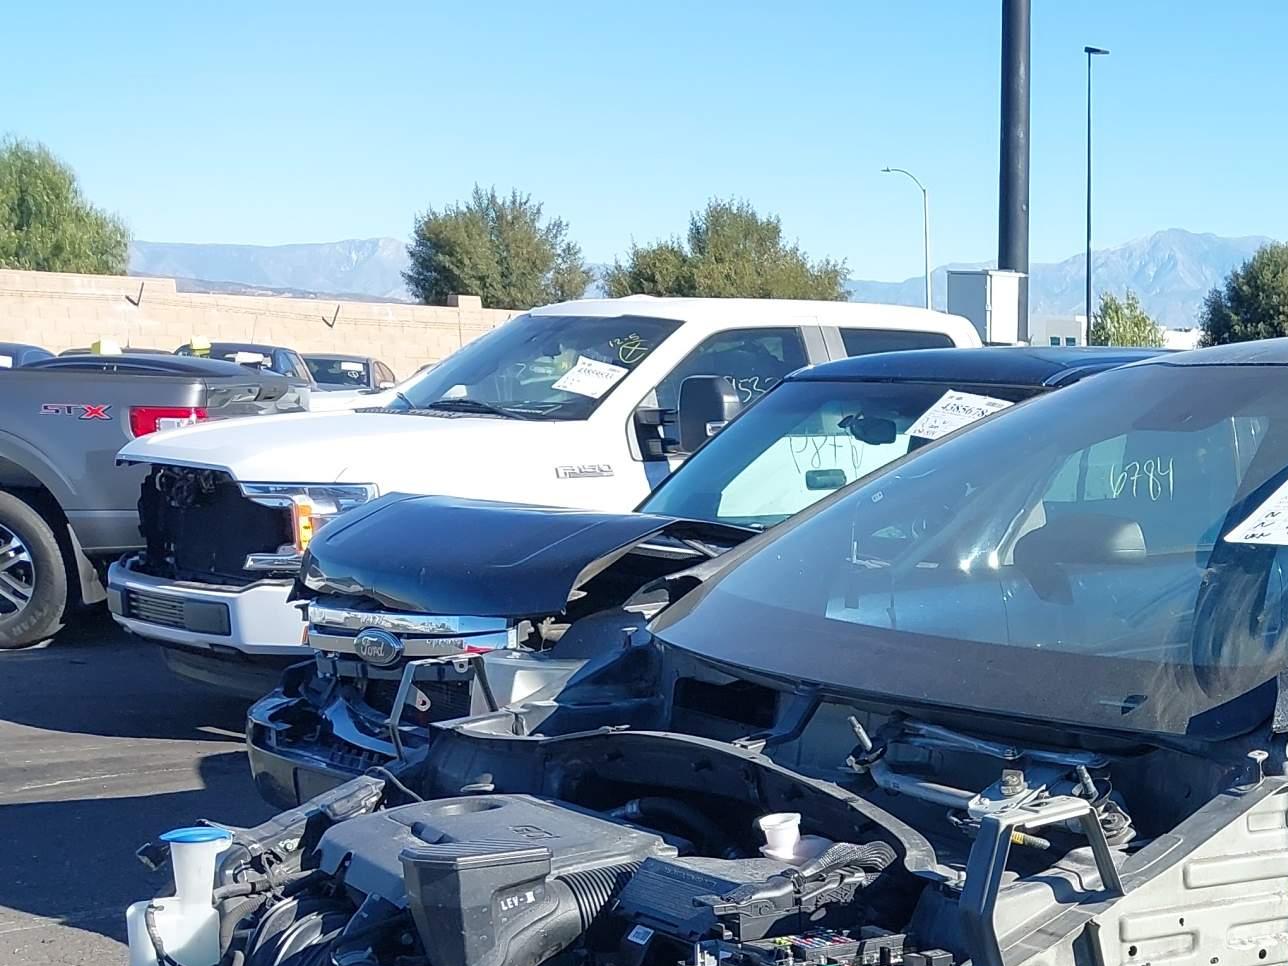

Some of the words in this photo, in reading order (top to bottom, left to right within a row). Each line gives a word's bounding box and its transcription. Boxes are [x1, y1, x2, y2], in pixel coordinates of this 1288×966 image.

[40, 403, 113, 421] STX
[1109, 456, 1174, 501] 6784
[360, 636, 385, 657] Ford
